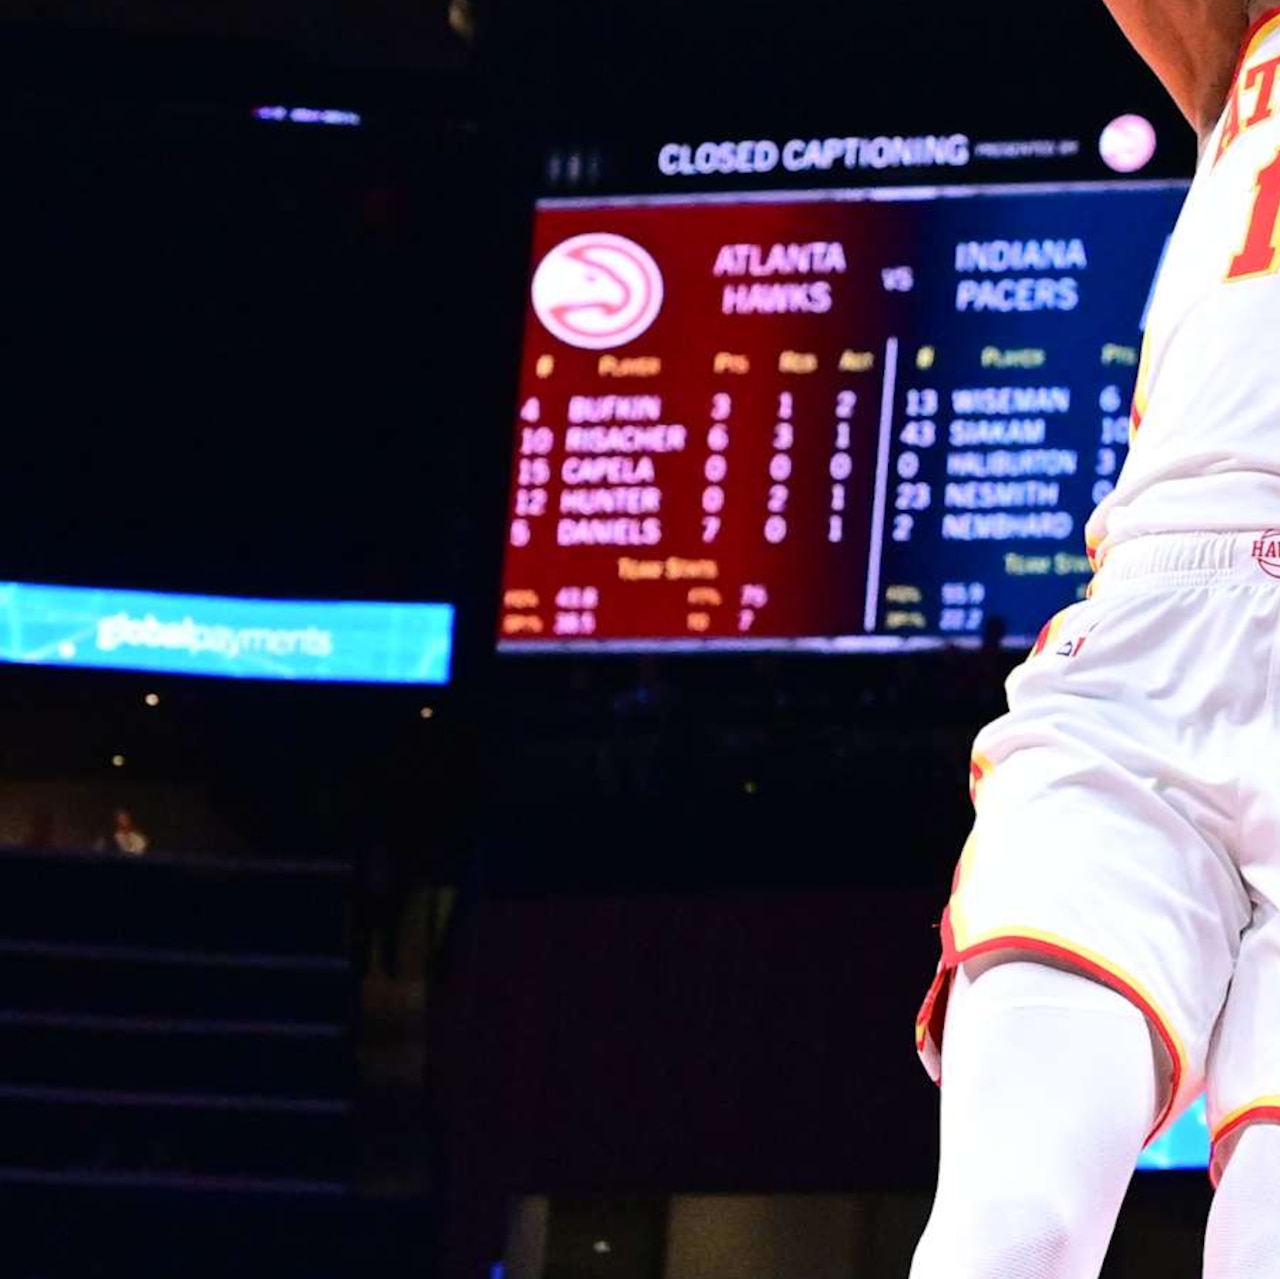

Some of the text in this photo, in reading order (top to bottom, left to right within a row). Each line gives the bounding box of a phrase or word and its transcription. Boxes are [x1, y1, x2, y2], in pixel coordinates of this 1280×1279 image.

[658, 142, 778, 176] CLOSED
[782, 133, 970, 173] CAPTIONING
[712, 242, 847, 276] ATLANTA
[954, 239, 1088, 272] INDIANA
[721, 282, 832, 314] HAWKS
[955, 277, 1079, 311] PACERS
[711, 392, 732, 420] 3
[835, 389, 857, 419] 2
[906, 388, 938, 417] 13
[951, 387, 1071, 414] WISEMAN
[521, 426, 554, 456] 10
[564, 424, 687, 452] RISACHER
[772, 421, 794, 450] 3
[899, 419, 937, 448] 43
[948, 419, 1046, 447] SIAKAM
[518, 451, 852, 486] 15 CAPELA 0 0 0
[896, 450, 920, 479] 0
[514, 487, 549, 516] 12
[559, 486, 663, 514] HUNTER
[702, 484, 725, 513] 0
[767, 483, 789, 513] 2
[894, 481, 932, 510] 23
[943, 481, 1060, 508] NESMITH
[556, 517, 663, 546] DANIELS
[702, 516, 722, 543] 7
[764, 515, 788, 544] 0
[891, 513, 914, 542] 2
